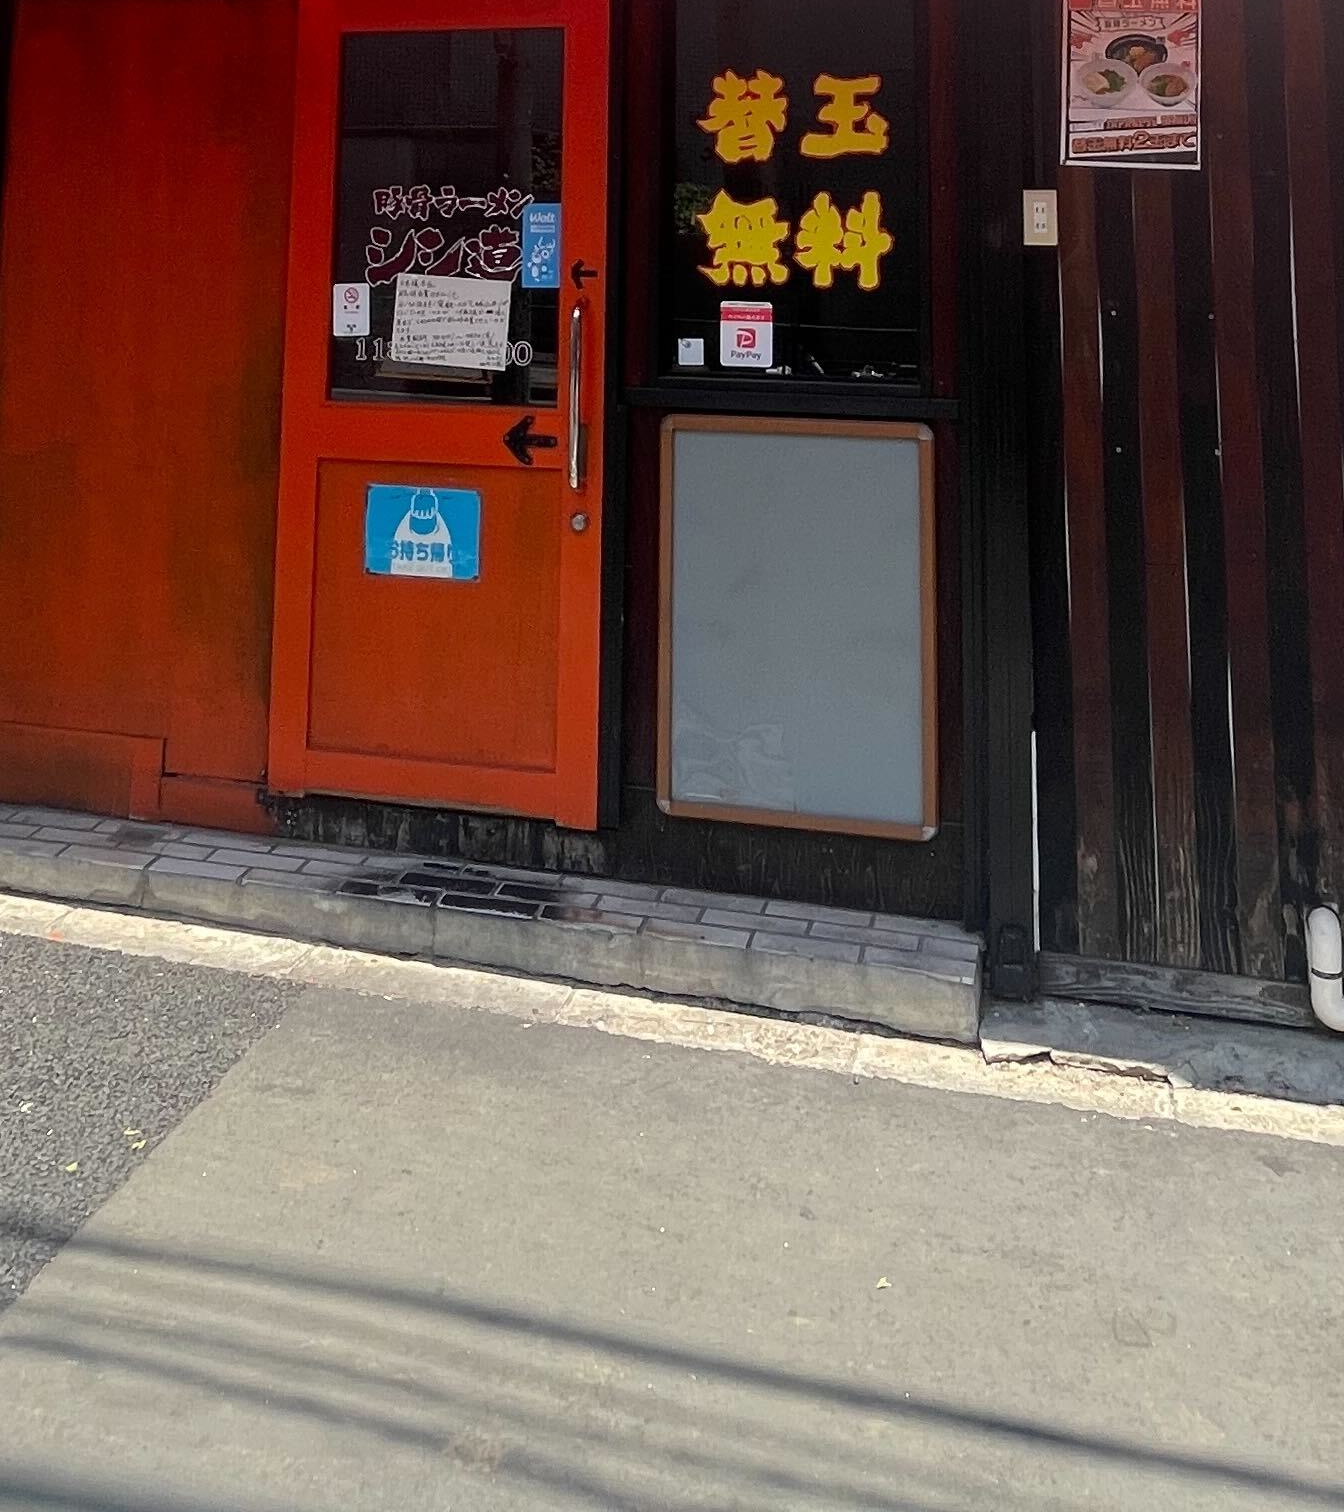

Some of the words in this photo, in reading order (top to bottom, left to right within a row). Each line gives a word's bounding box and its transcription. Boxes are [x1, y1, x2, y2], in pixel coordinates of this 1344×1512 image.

[696, 69, 889, 164] 替玉
[373, 184, 535, 221] 豚骨ラーメン
[696, 189, 894, 291] 無料
[729, 350, 762, 362] PayPay
